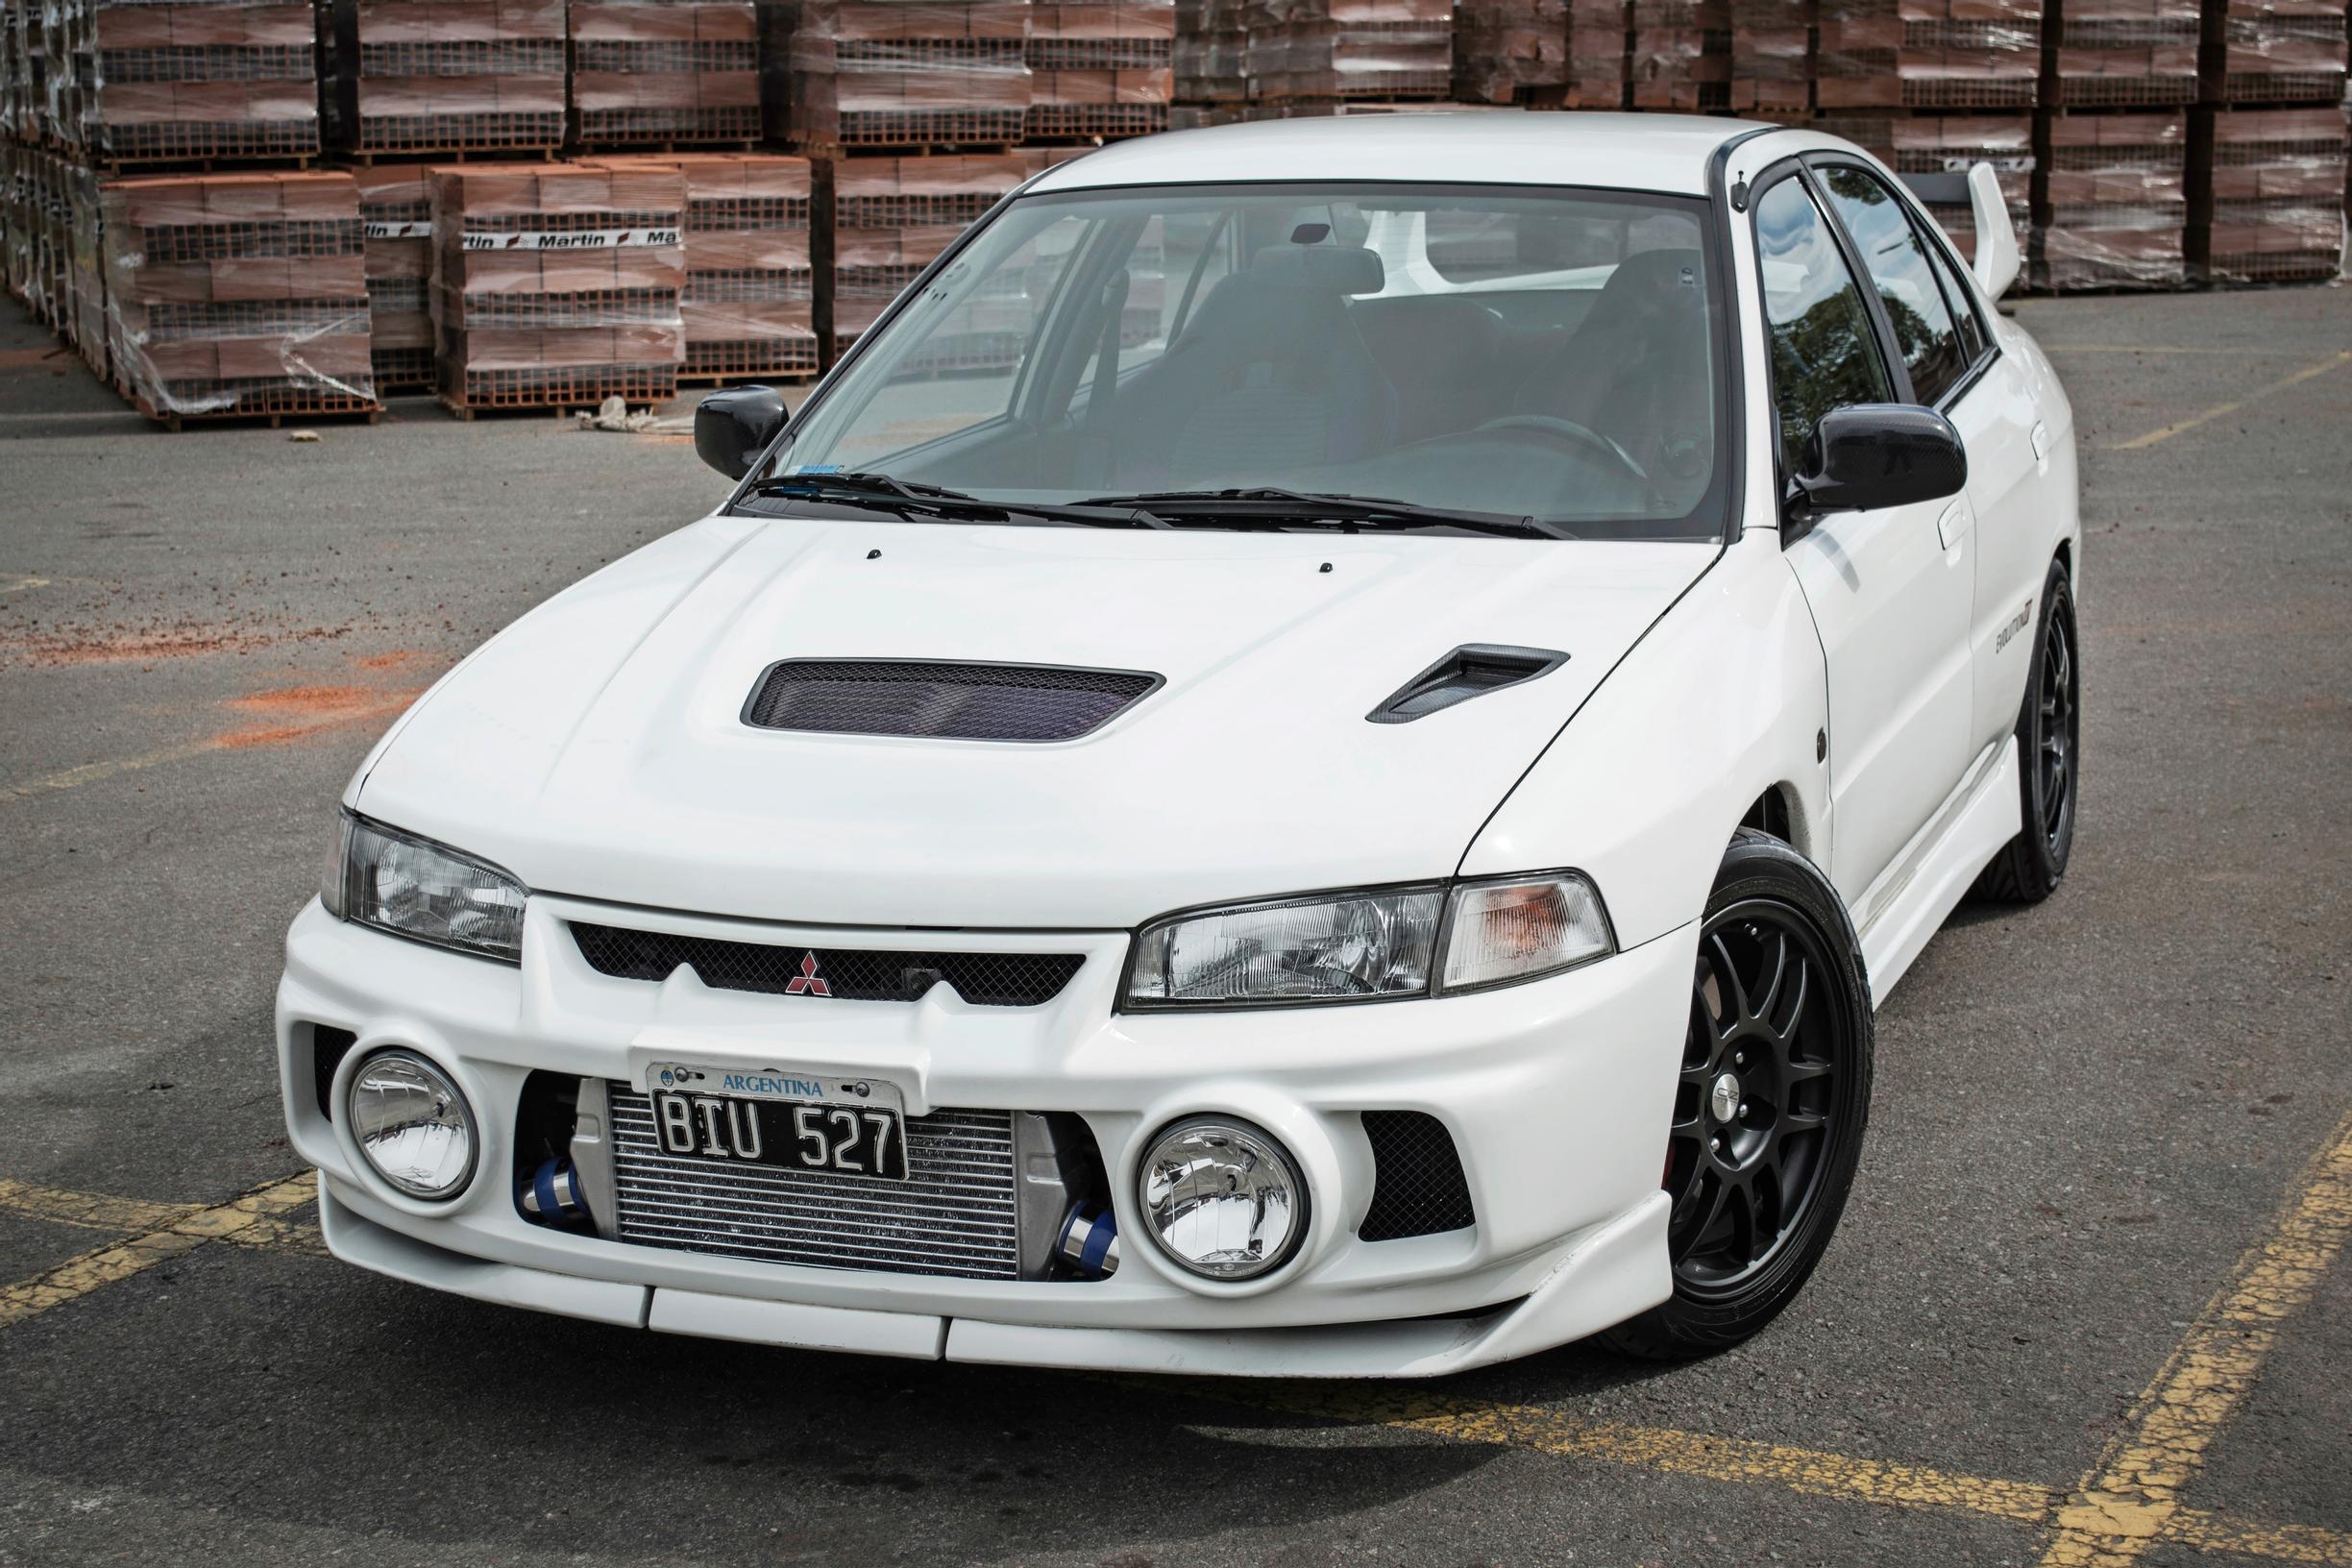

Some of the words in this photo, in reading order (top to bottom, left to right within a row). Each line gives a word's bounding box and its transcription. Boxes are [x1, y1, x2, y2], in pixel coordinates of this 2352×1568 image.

[538, 234, 605, 247] Martin
[723, 1074, 824, 1096] ARGENTINA
[660, 1093, 763, 1159] BIU
[795, 1106, 893, 1174] 527
